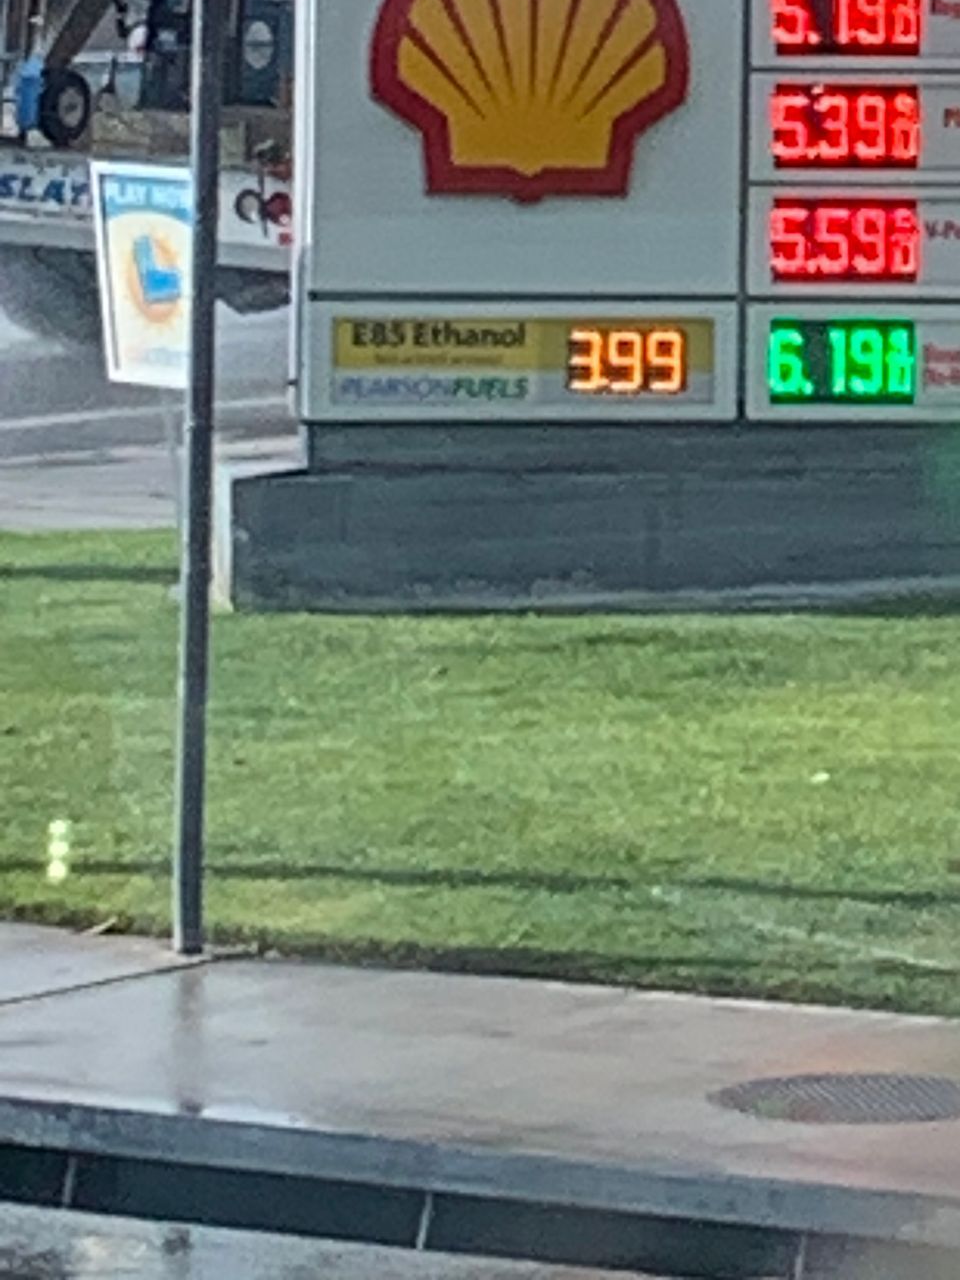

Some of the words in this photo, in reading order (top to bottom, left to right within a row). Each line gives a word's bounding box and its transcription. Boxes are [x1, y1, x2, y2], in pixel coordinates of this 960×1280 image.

[352, 320, 405, 347] E85
[412, 320, 526, 348] Ethanol
[569, 330, 685, 391] 3.99
